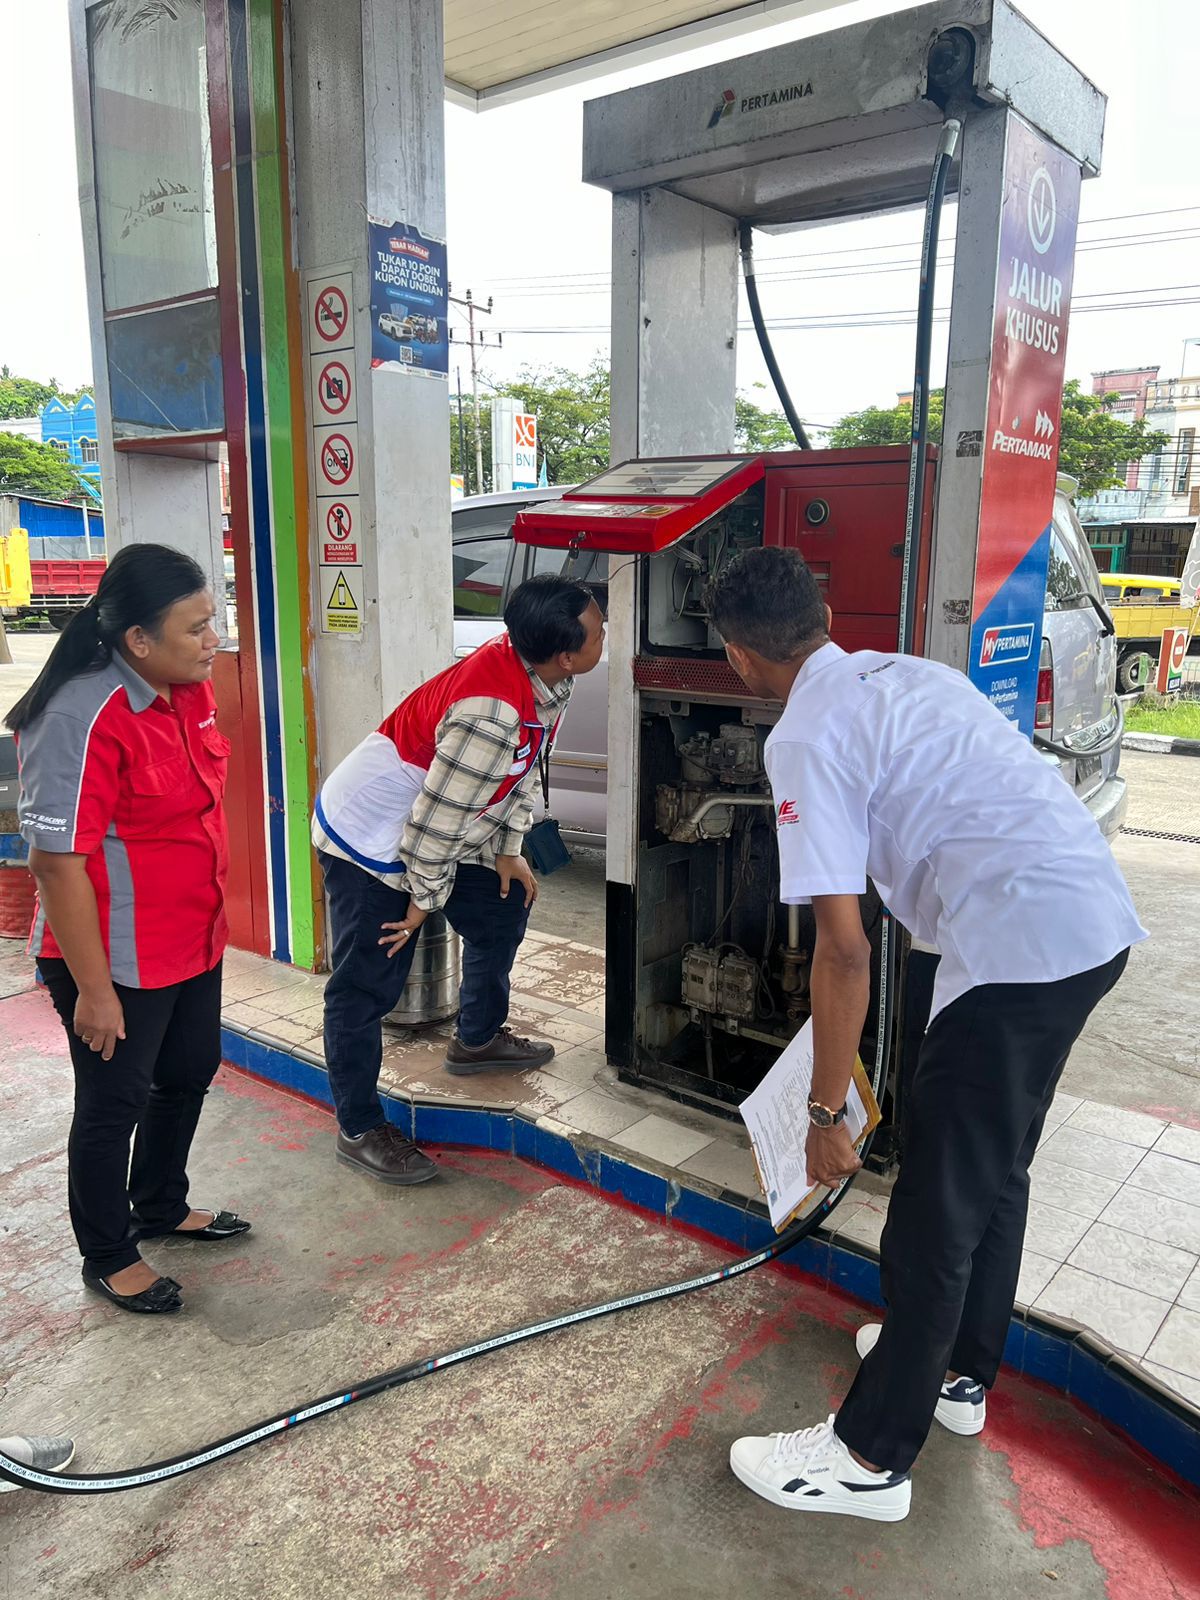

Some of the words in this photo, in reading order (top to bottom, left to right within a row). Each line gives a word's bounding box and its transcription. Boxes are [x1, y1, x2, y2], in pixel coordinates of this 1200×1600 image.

[741, 82, 813, 112] PERTAMINA
[377, 251, 407, 268] TUKAR
[408, 260, 418, 270] 10
[420, 264, 440, 278] POIN
[381, 262, 410, 278] DAPAT
[412, 270, 438, 286] DOBEL
[374, 271, 408, 288] KUPON
[410, 280, 443, 296] UNDIAN
[1008, 256, 1062, 318] JALUR
[1005, 306, 1060, 355] KHUSUS
[992, 430, 1052, 460] PERTAMAX
[516, 452, 535, 468] BNI
[991, 677, 1018, 692] DOWNLOAD
[220, 1428, 262, 1454] TECHNOLOGY
[263, 1424, 276, 1437] USA
[157, 1464, 184, 1478] RUBBER
[186, 1450, 218, 1468] GASOLINE
[138, 1473, 156, 1483] HOSE
